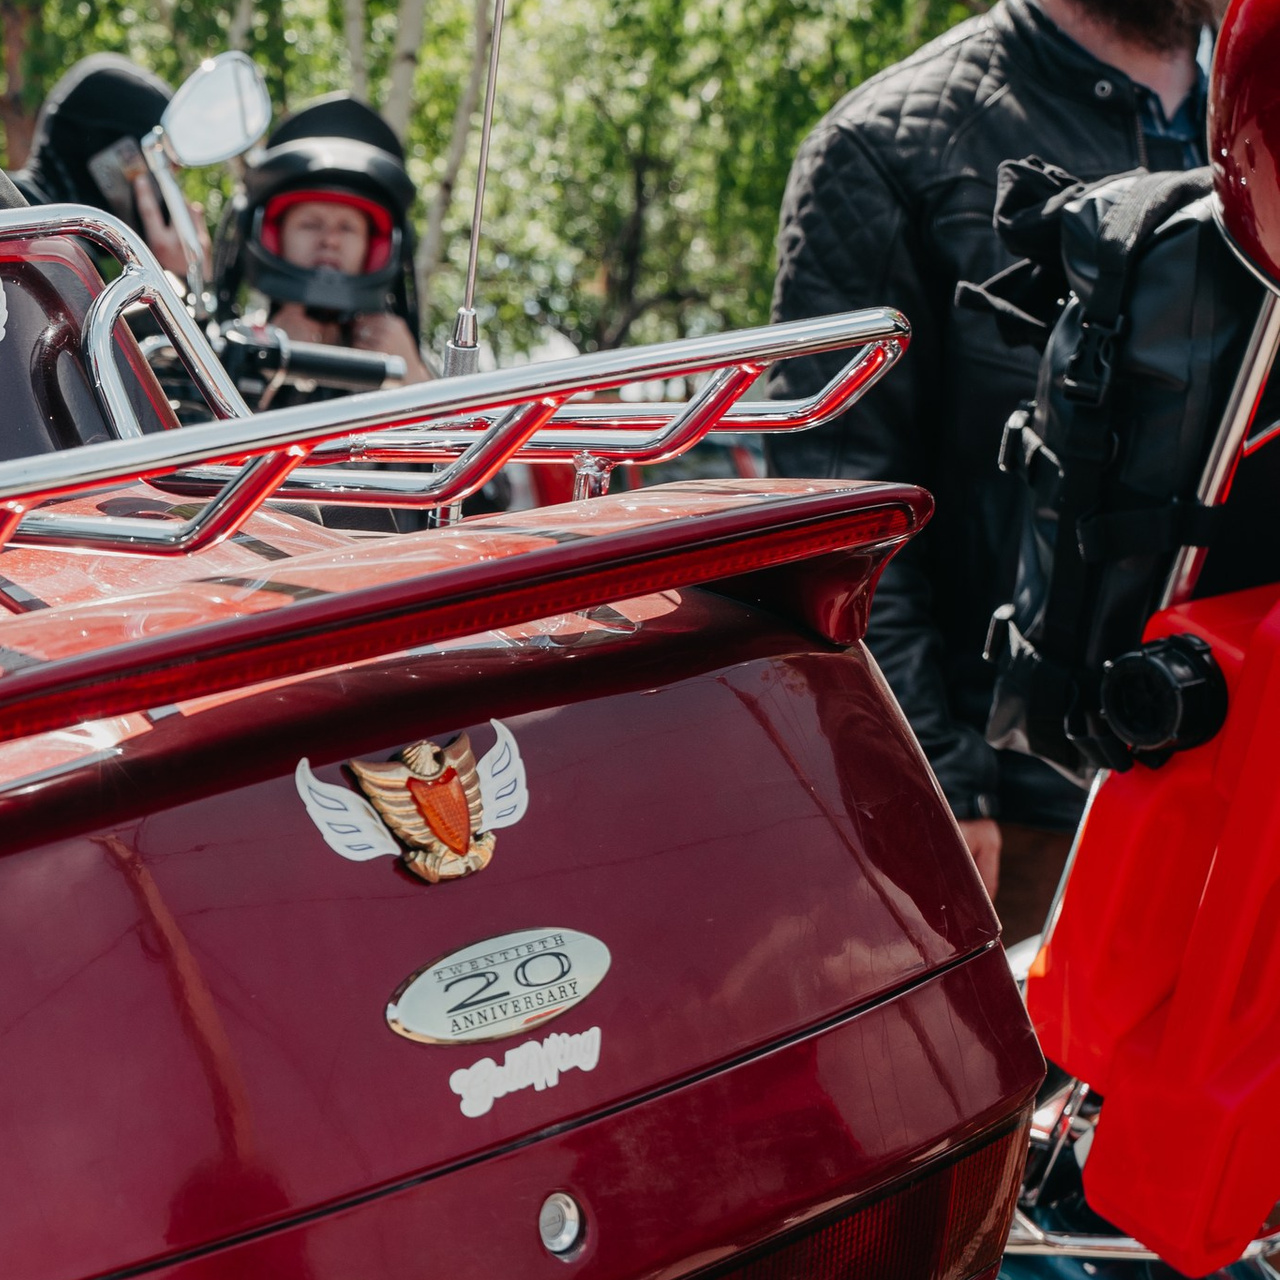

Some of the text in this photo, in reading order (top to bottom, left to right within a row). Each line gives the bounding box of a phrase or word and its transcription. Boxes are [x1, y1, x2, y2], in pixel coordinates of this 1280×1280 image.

[433, 934, 566, 980] TWENTIETH
[443, 951, 572, 1014] 20
[450, 981, 580, 1033] ANNIVERSARY
